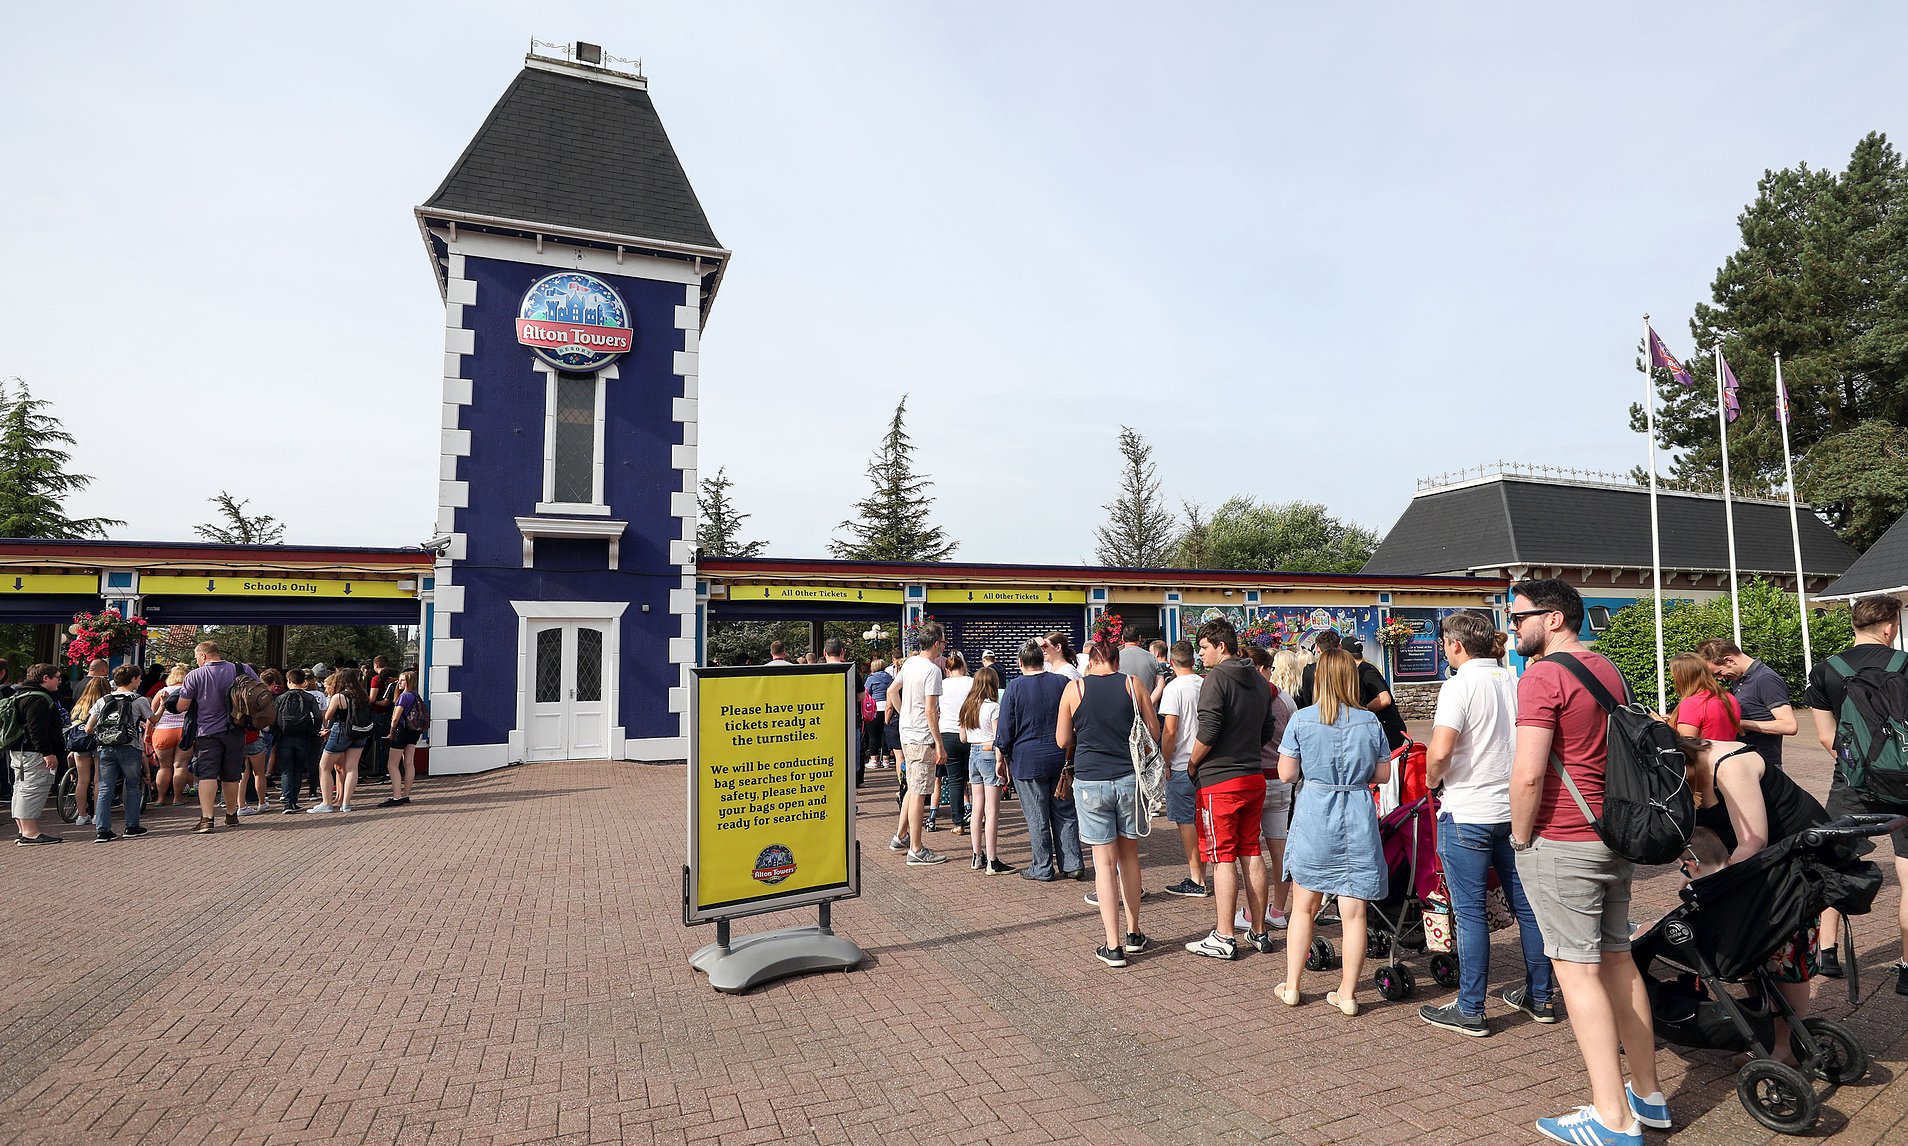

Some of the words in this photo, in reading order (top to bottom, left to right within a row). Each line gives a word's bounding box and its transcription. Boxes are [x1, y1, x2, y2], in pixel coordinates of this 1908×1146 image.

[523, 323, 568, 343] Alton
[570, 328, 627, 348] Towers
[559, 346, 592, 356] RESORT
[243, 582, 287, 591] Schools
[290, 583, 317, 594] Only
[781, 589, 793, 597] All
[795, 589, 817, 597] Other
[819, 590, 848, 598] Tickets
[983, 592, 994, 600] All
[995, 592, 1014, 600] Other
[721, 705, 762, 716] Please
[765, 703, 794, 714] have
[797, 702, 825, 714] your
[725, 719, 769, 731] tickets
[771, 716, 806, 729] ready
[809, 716, 821, 726] at
[732, 735, 753, 746] the
[756, 730, 818, 744] turnstiles.
[710, 765, 729, 775] We
[732, 762, 754, 773] will
[757, 761, 770, 771] be
[773, 756, 835, 770] conducting
[714, 779, 736, 790] bag
[738, 774, 788, 787] searches
[790, 771, 806, 782] for
[809, 770, 834, 782] your
[720, 791, 760, 802] safety,
[762, 788, 797, 800] please
[799, 784, 826, 794] have
[718, 806, 747, 819] your
[749, 803, 776, 814] bags
[778, 799, 805, 812] open
[807, 795, 828, 806] and
[717, 818, 751, 831] ready
[753, 816, 771, 826] for
[773, 809, 829, 824] searching.
[772, 867, 794, 875] Towers
